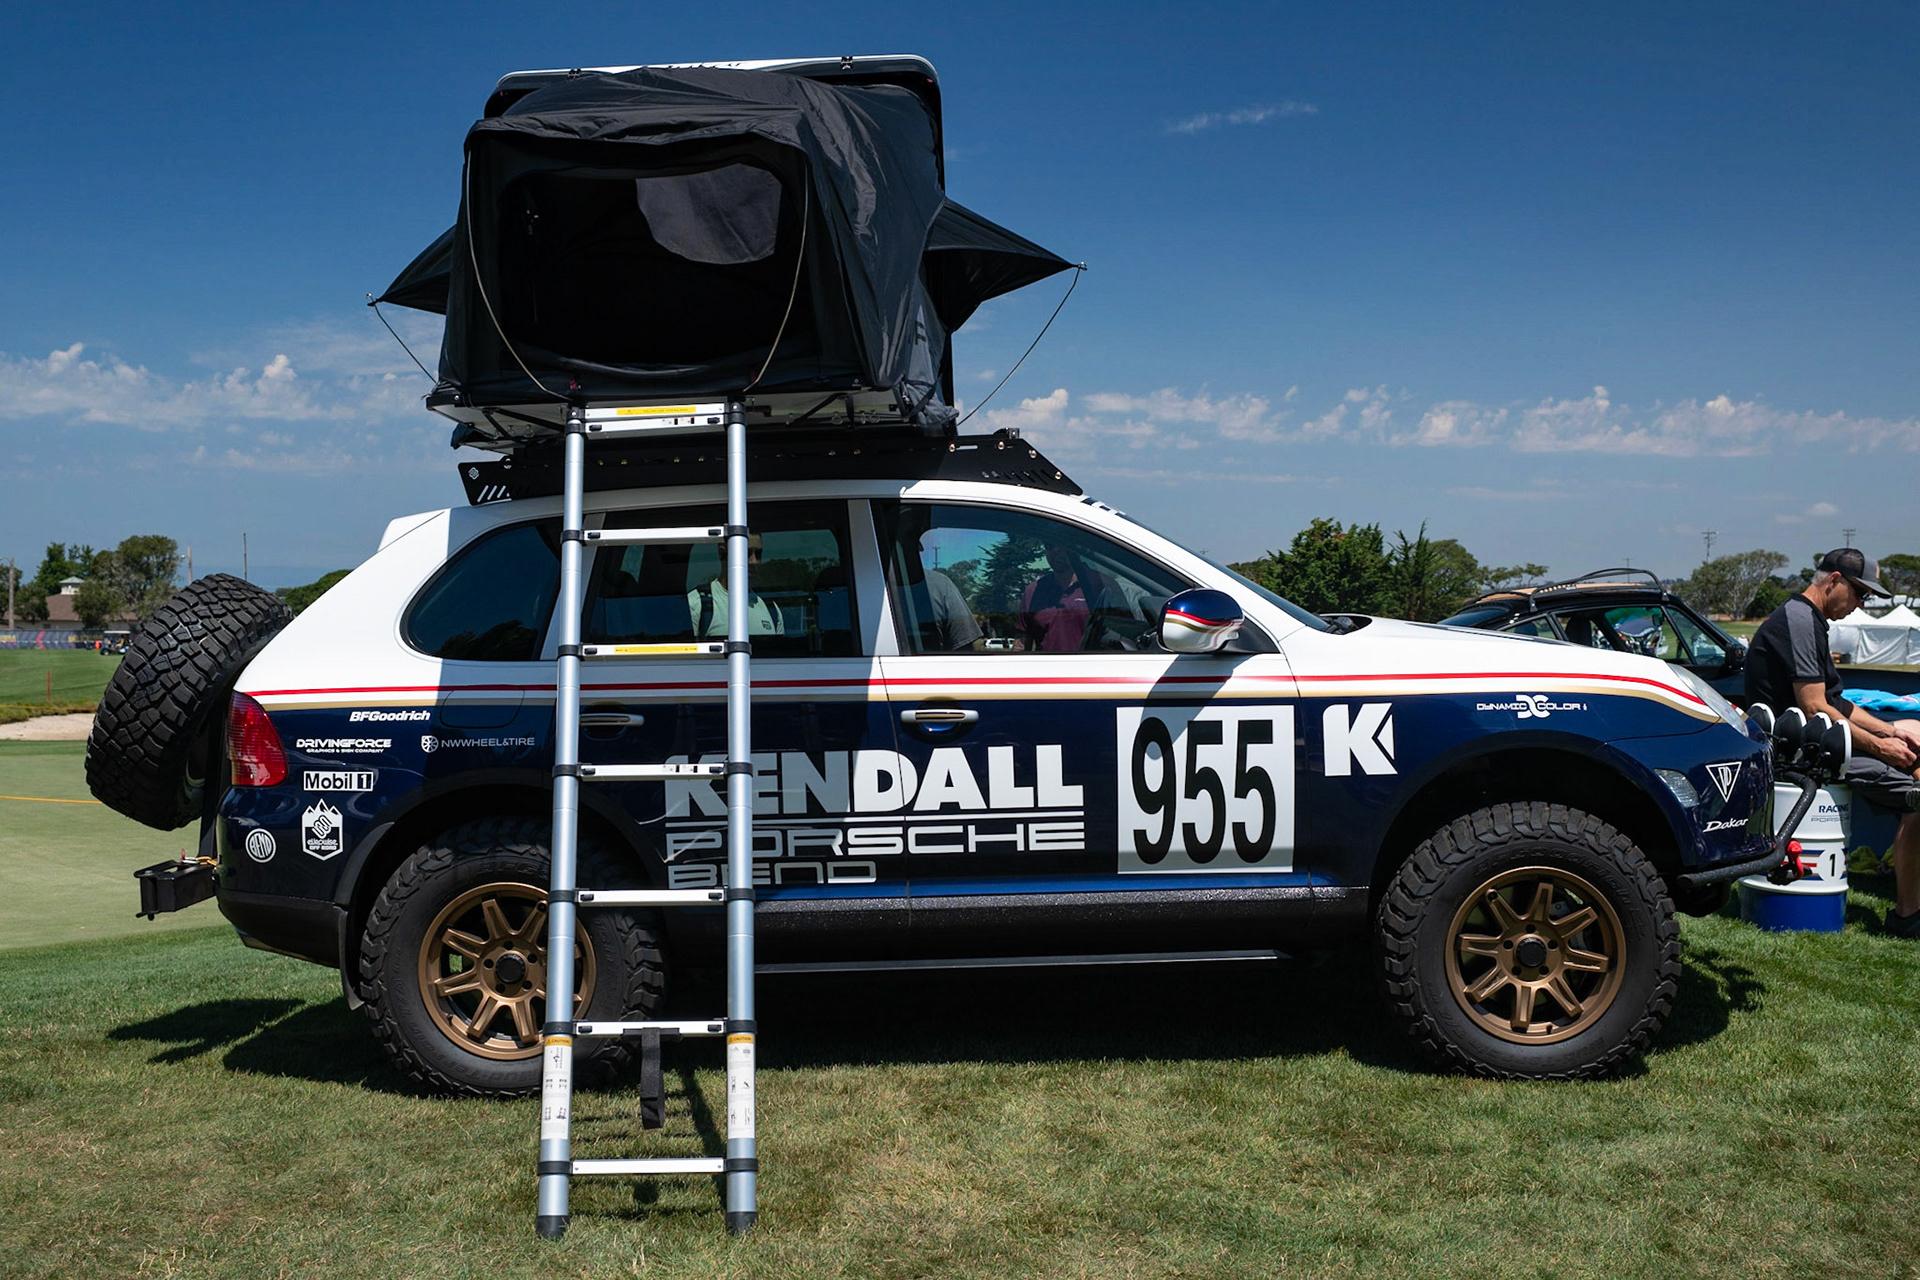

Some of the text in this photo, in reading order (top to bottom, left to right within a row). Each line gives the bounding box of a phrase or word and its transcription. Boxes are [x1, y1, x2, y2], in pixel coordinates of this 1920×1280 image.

[349, 710, 431, 722] BFGoodrich
[1322, 703, 1398, 776] K
[305, 773, 352, 789] Mobil
[1131, 716, 1276, 864] 955
[1702, 817, 1749, 832] Dakar
[249, 832, 272, 858] BEND
[666, 821, 1085, 857] PORSCHE
[1829, 853, 1836, 877] 1
